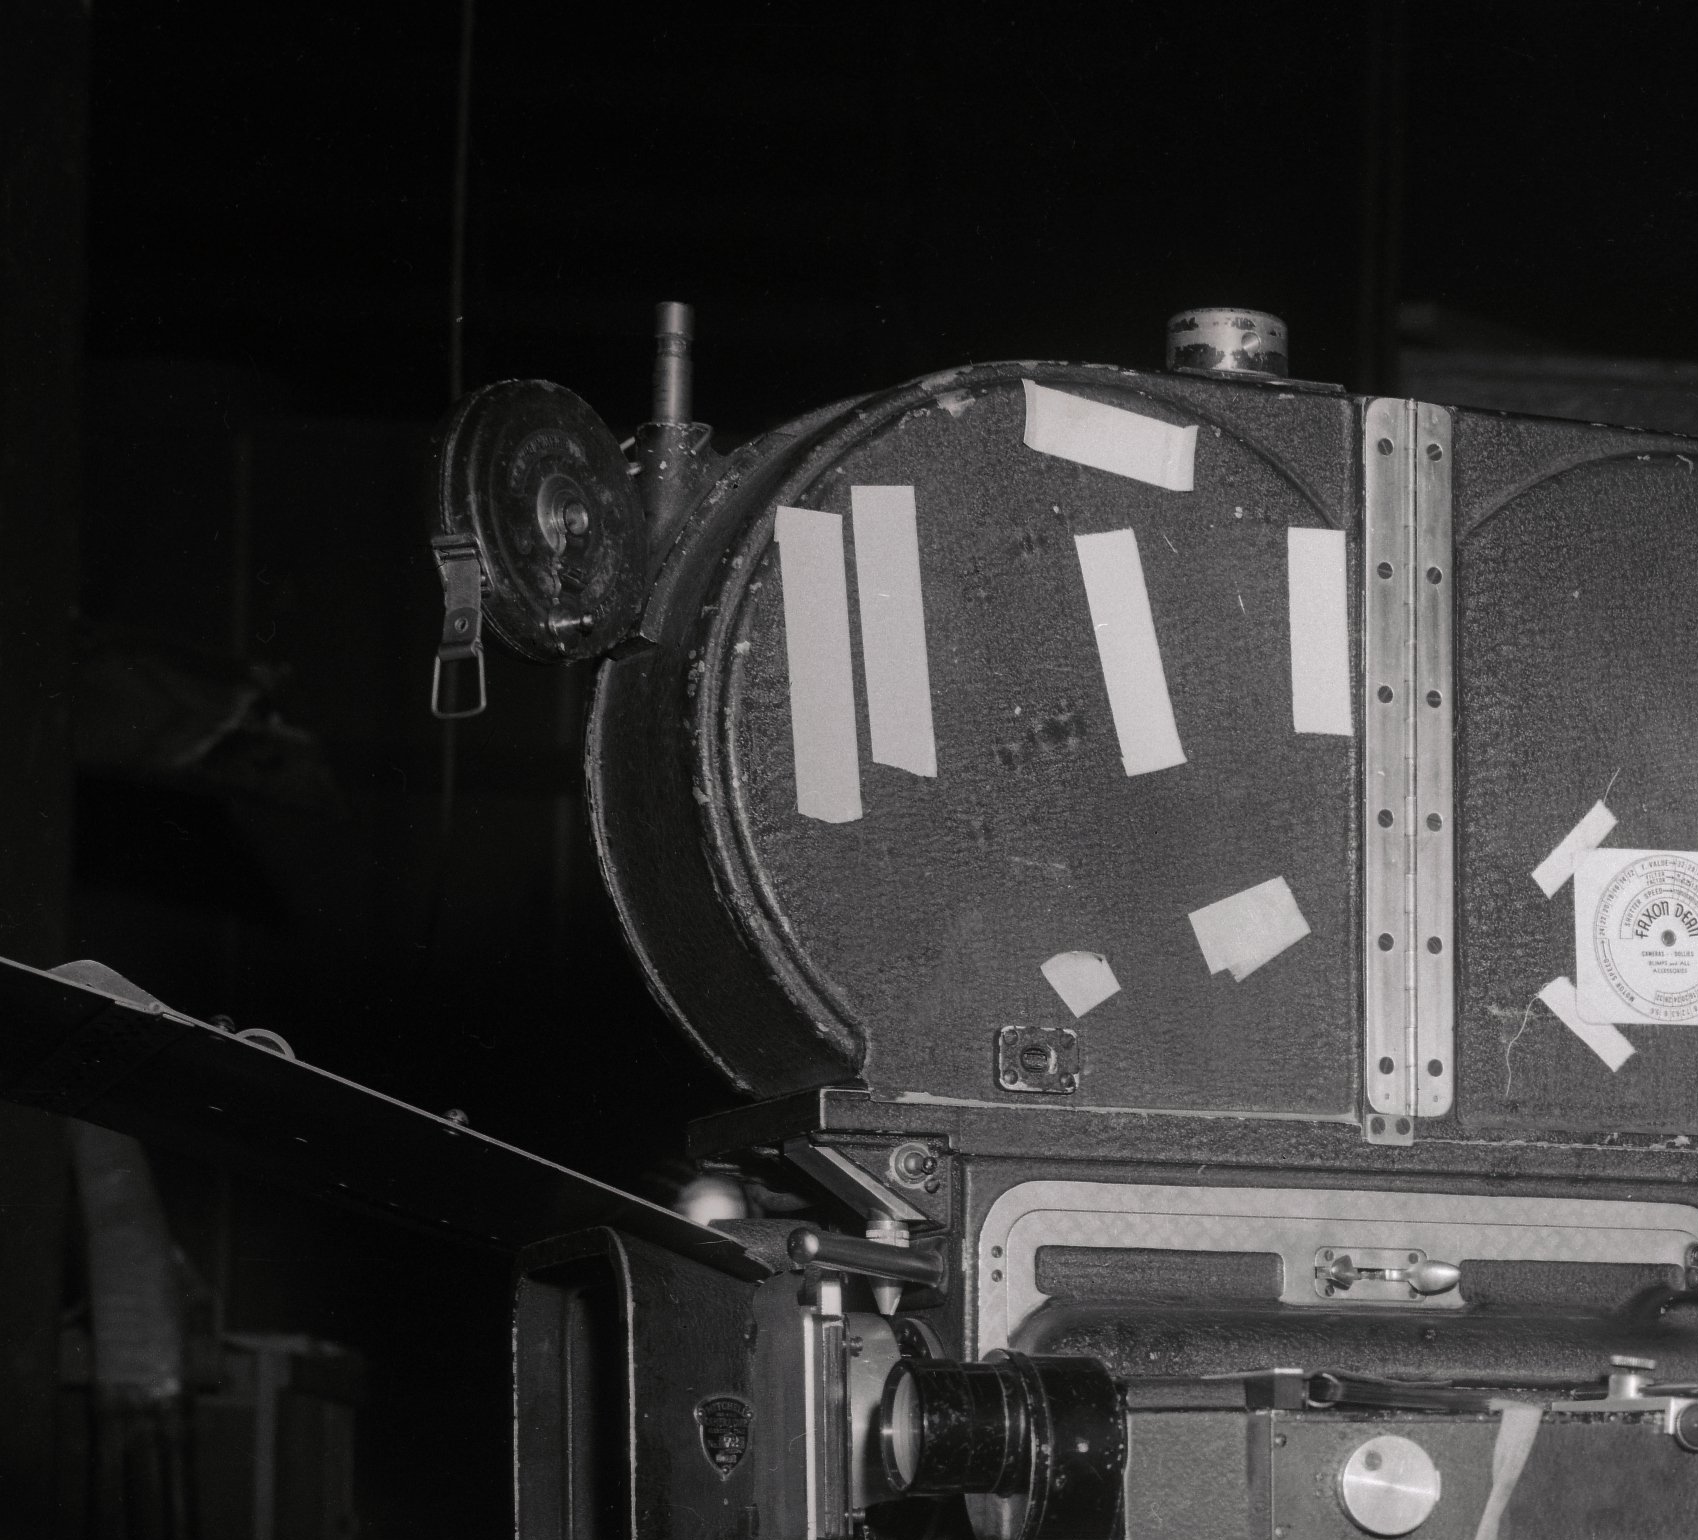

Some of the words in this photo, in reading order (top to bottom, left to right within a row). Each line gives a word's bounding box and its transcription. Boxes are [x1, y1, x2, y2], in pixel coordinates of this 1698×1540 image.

[1648, 860, 1668, 868] VALUE
[1646, 872, 1665, 880] FILTER
[1646, 878, 1665, 886] FACTOR
[1624, 898, 1642, 927] SHUTTER
[1644, 888, 1663, 898] SPEED
[1636, 901, 1669, 939] FAXON
[1604, 958, 1618, 980] SPEED
[1616, 982, 1634, 1002] MOTOR
